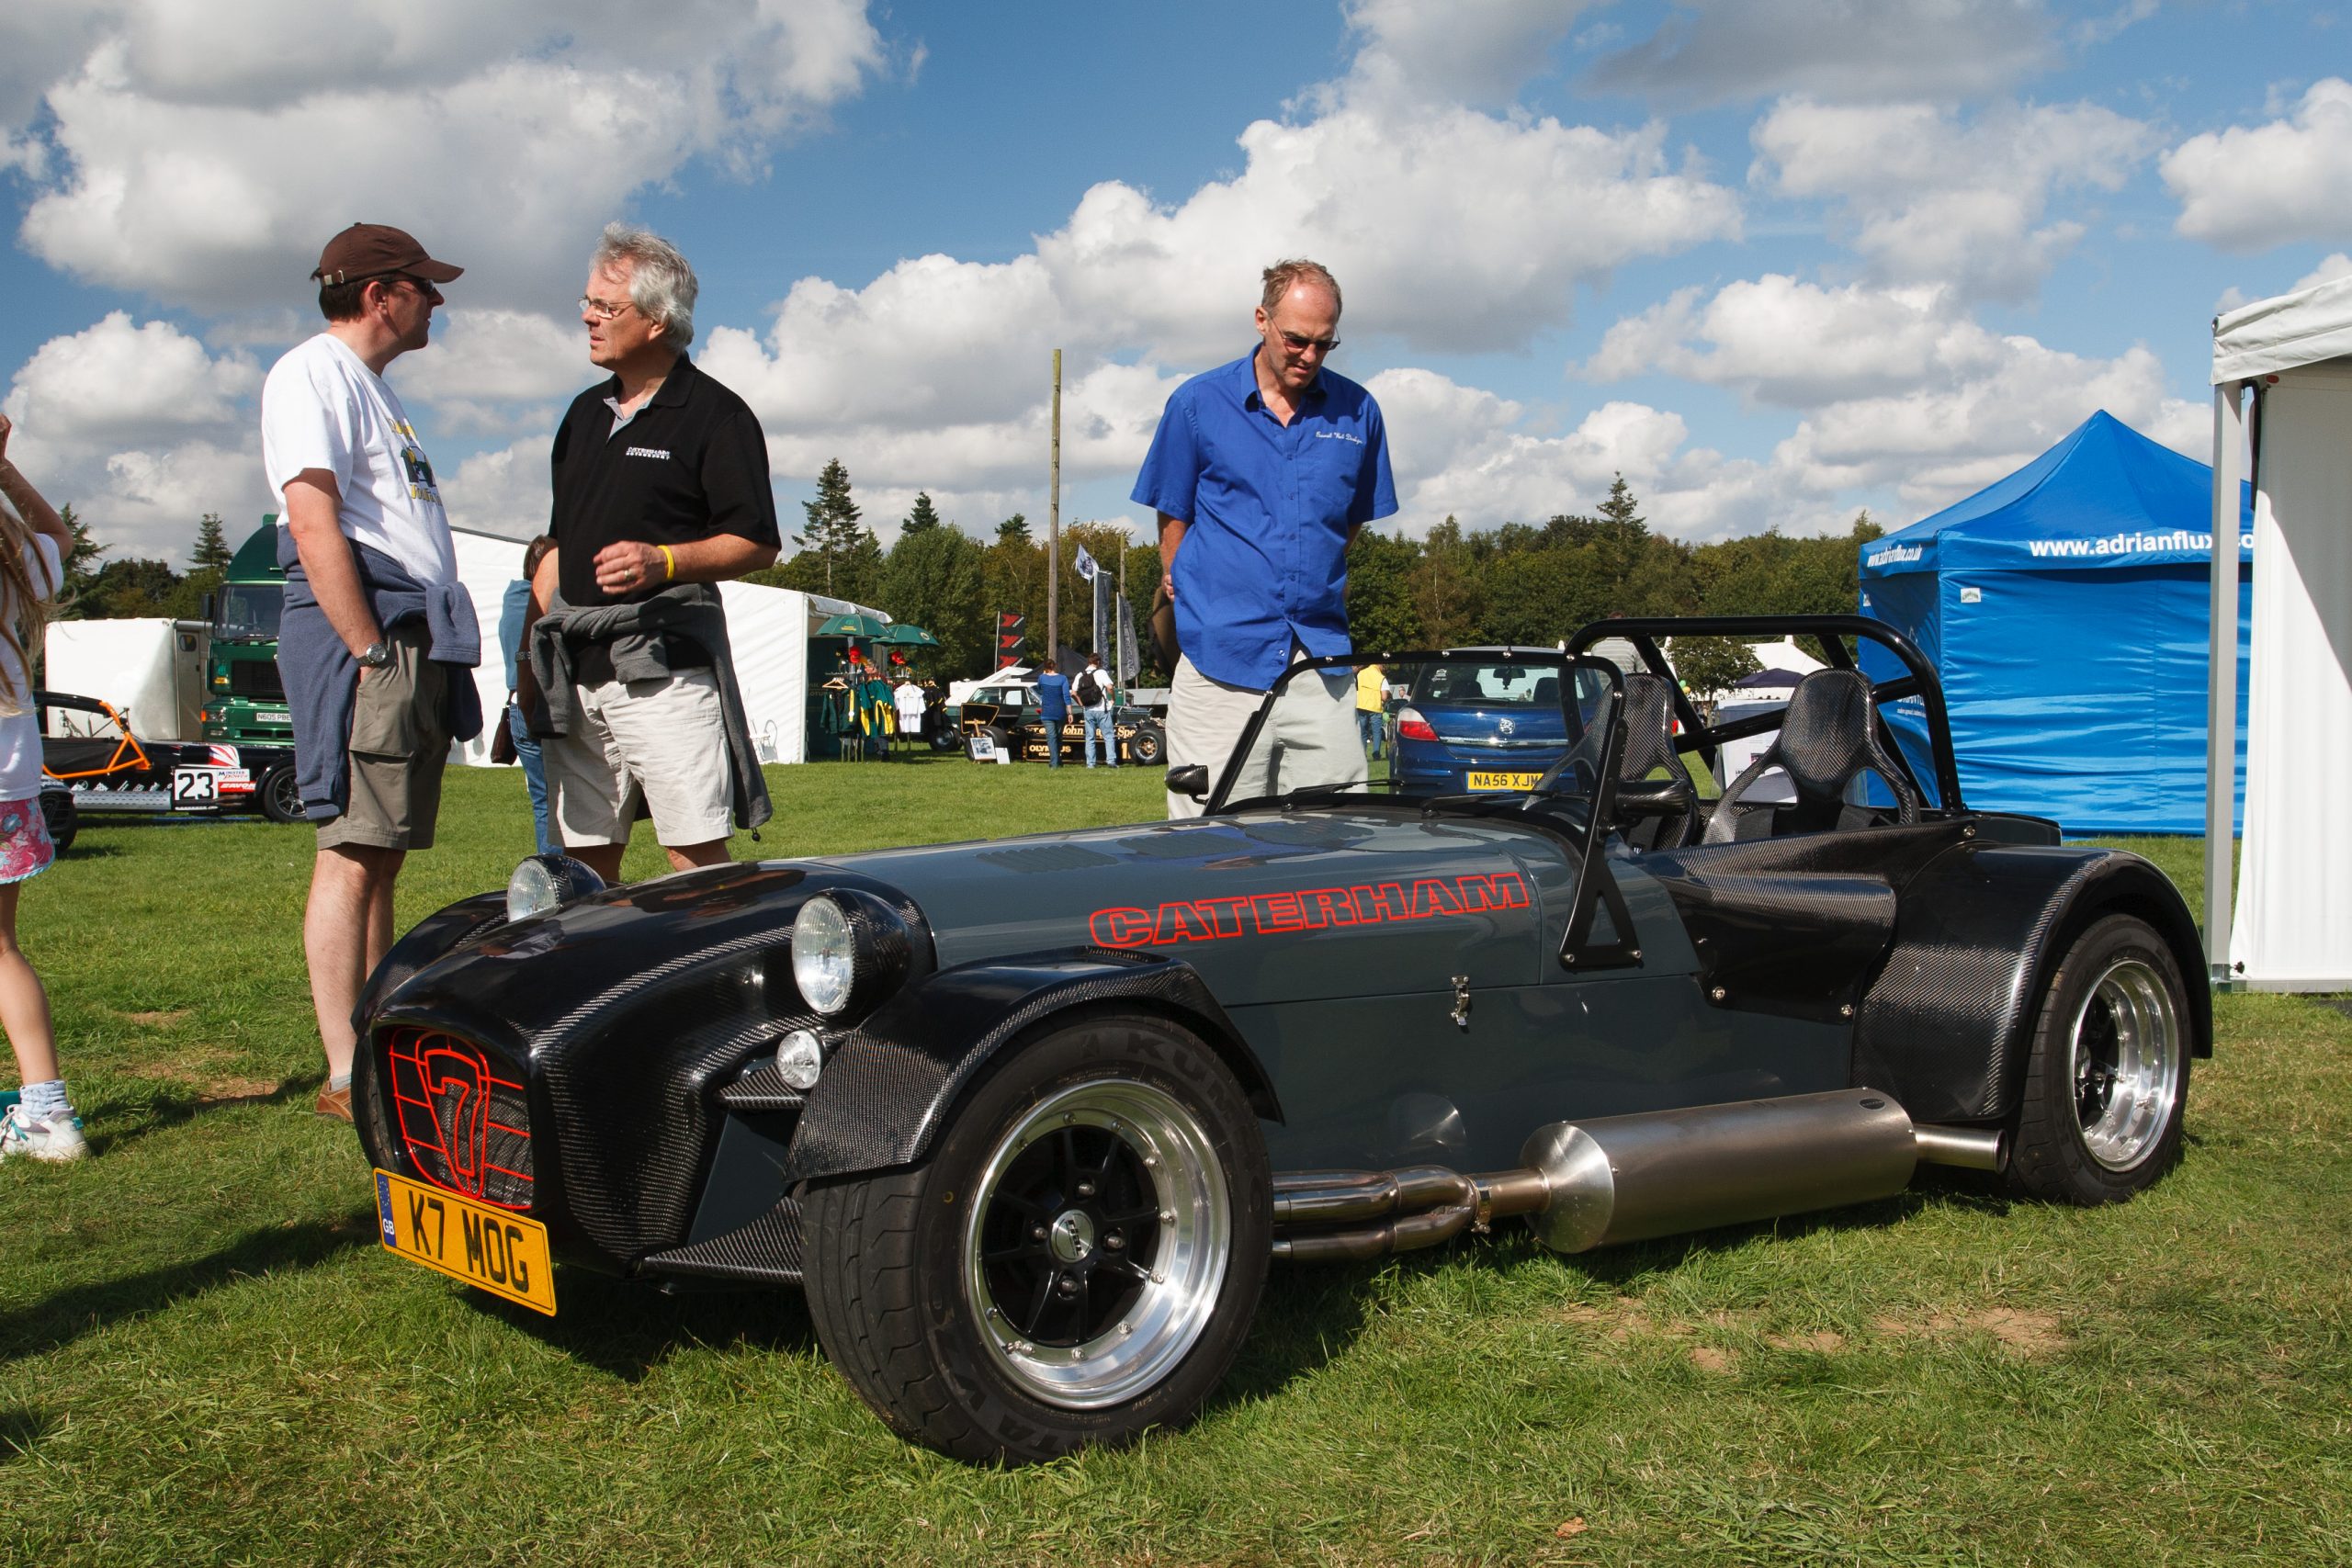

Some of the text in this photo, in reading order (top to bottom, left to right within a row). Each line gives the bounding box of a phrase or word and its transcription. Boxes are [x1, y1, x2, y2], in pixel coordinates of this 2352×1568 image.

[178, 773, 213, 799] 23
[1474, 774, 1508, 786] NA56
[1089, 872, 1530, 948] CATERHAM
[382, 1218, 395, 1235] GB
[408, 1189, 530, 1294] K7 MOG
